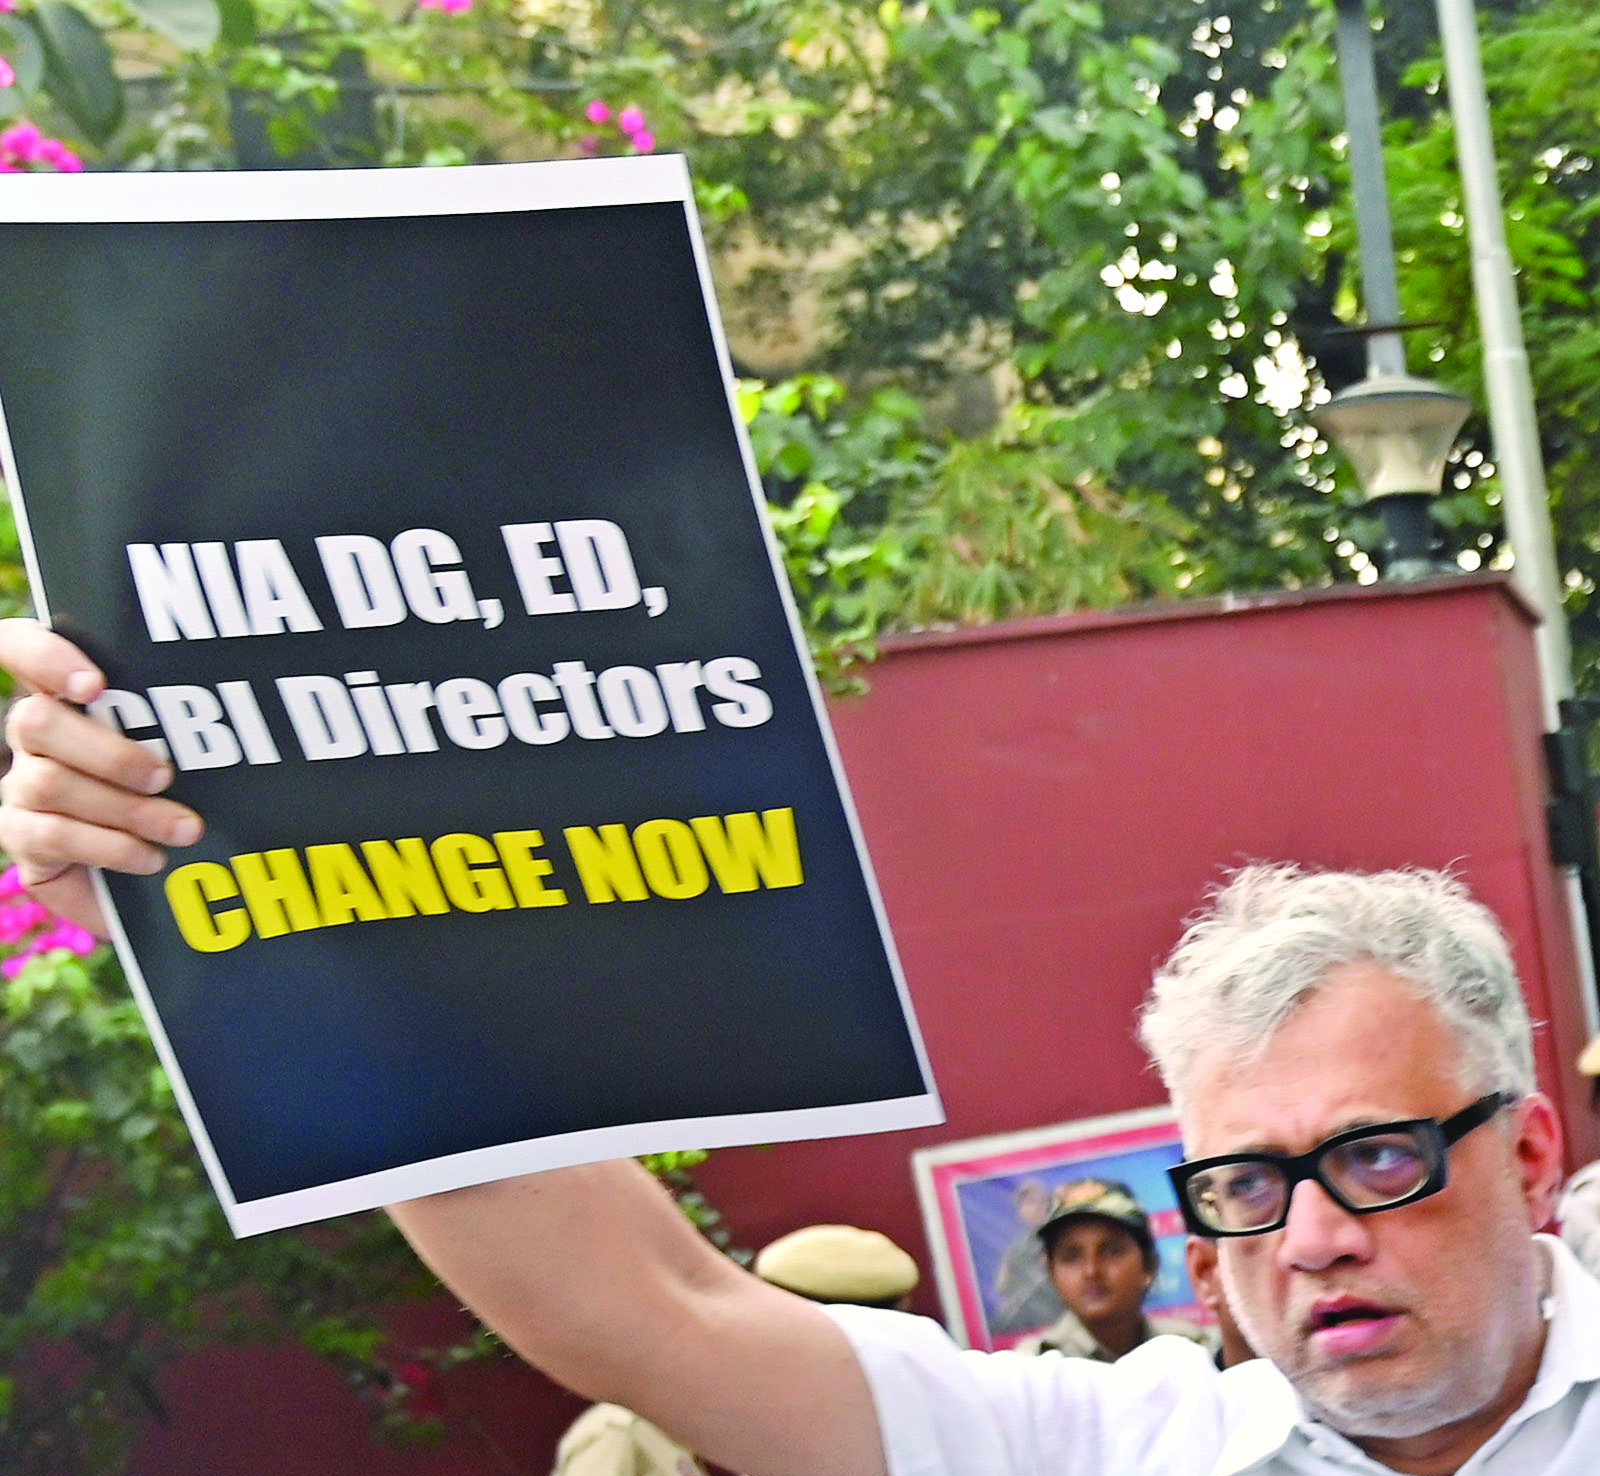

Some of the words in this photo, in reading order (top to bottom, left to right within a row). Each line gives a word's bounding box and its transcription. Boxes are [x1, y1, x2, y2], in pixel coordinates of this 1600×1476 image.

[127, 540, 316, 642] NIA
[320, 529, 504, 631] DG,
[505, 520, 667, 617] ED,
[86, 680, 280, 771] CBI
[281, 657, 772, 760] Directors
[166, 830, 566, 952] CHANGE
[570, 808, 804, 904] NOW
